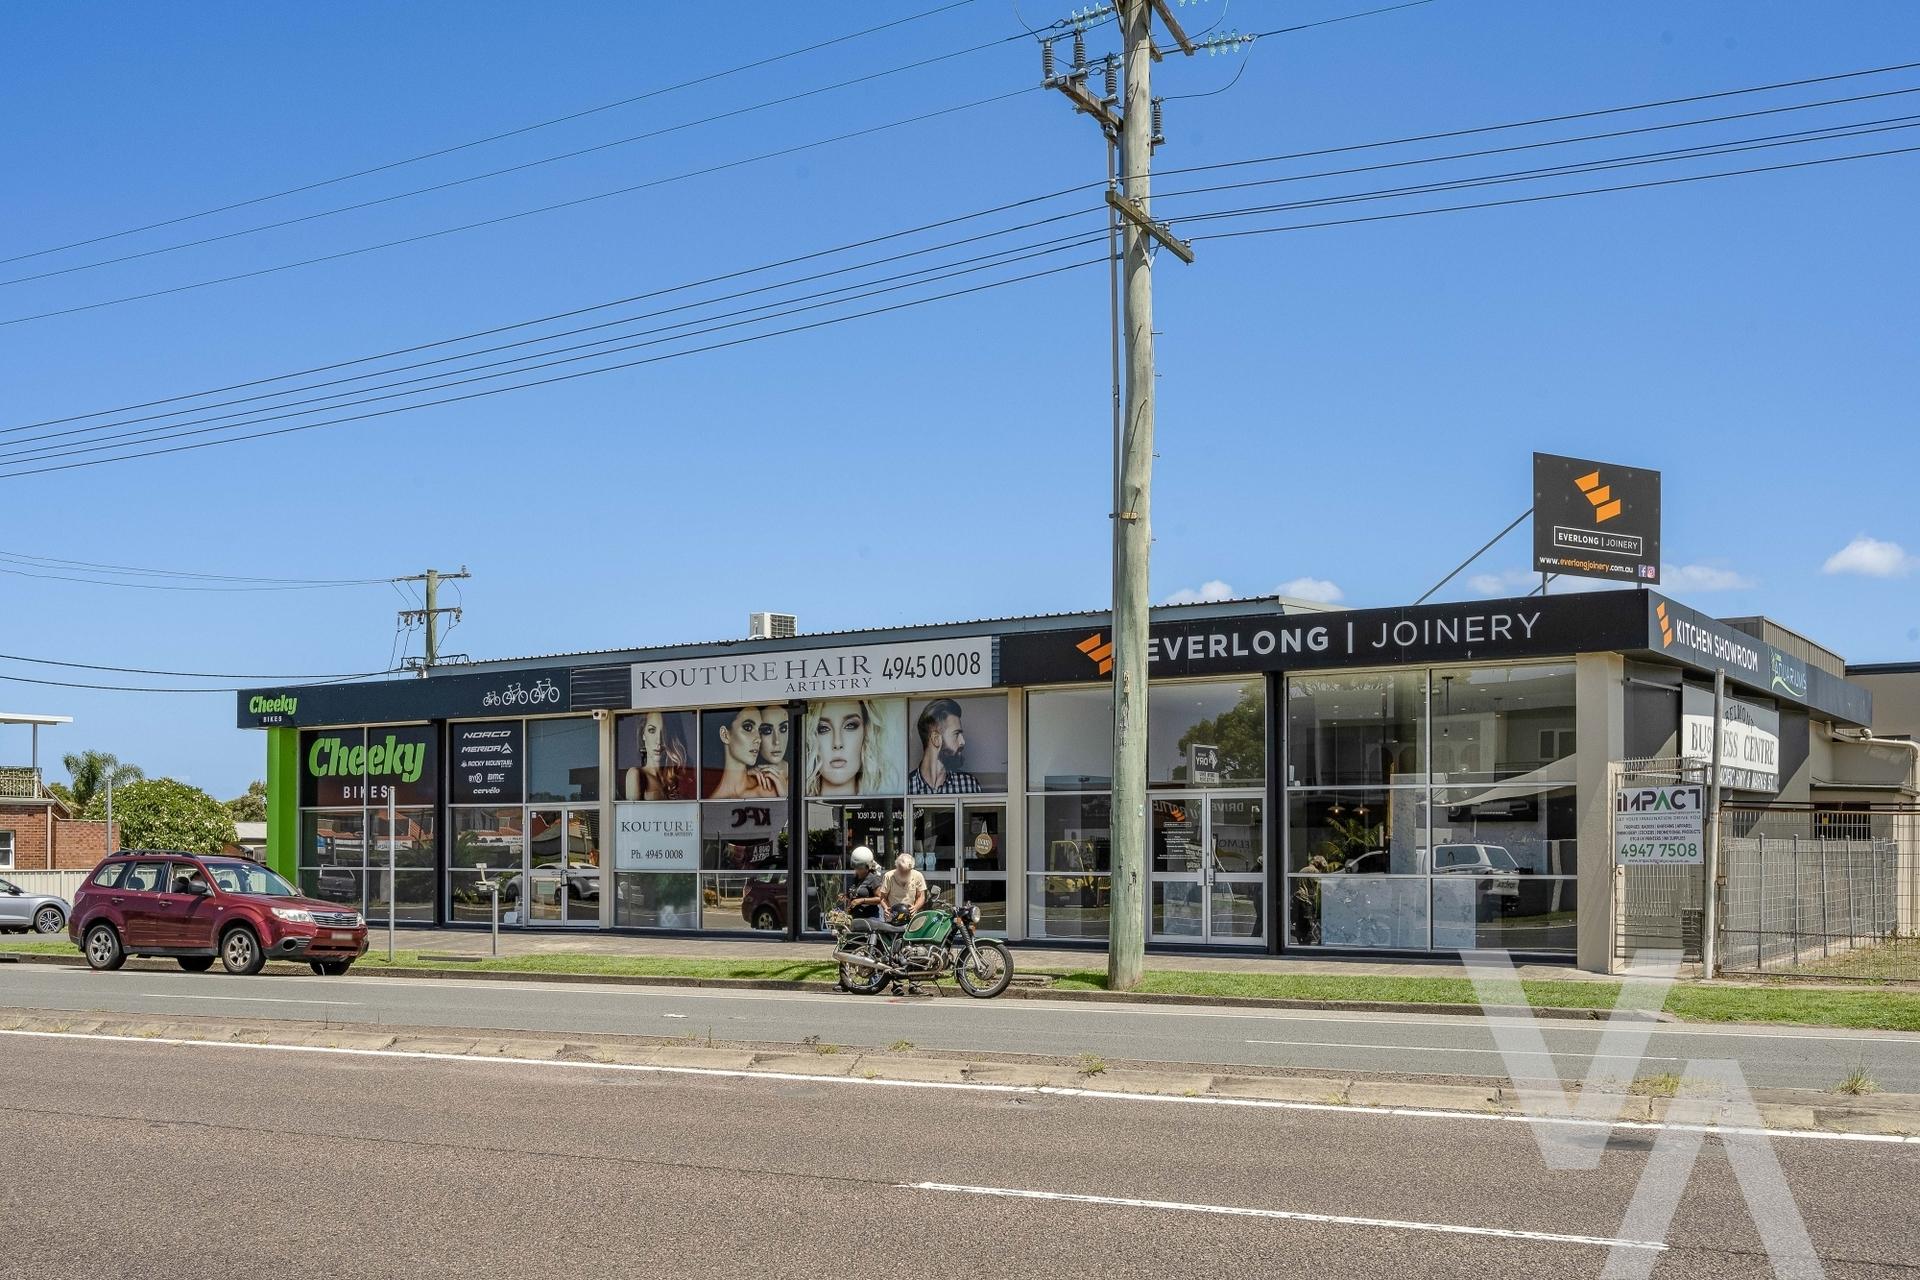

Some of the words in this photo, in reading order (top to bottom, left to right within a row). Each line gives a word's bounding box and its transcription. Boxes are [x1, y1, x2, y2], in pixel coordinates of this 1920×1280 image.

[1558, 532, 1599, 545] EVERLONG
[1605, 539, 1638, 550] JOINERY
[1539, 556, 1634, 573] www.everlongjoinery.com.au
[1147, 626, 1329, 662] EVERLONG
[1371, 611, 1541, 648] JOINERY
[1676, 618, 1713, 655] KITCHEN
[1714, 634, 1759, 672] SHOWROOM
[639, 661, 778, 690] KOUTURE
[785, 655, 872, 680] HAIR
[882, 655, 926, 680] 4945
[931, 651, 981, 677] 0008
[785, 677, 872, 693] ARTISTRY
[249, 694, 298, 715] Cheeky
[263, 715, 283, 723] BIKES
[1725, 703, 1755, 733] BELMONT
[462, 730, 512, 739] NORCO
[461, 745, 502, 753] MERIDA
[1691, 722, 1739, 759] BUSESS
[1743, 735, 1775, 766] CENTRE
[308, 735, 426, 783] Cheeky
[343, 785, 389, 799] BIKES
[621, 820, 694, 832] KOUTURE
[645, 849, 663, 859] 4945
[664, 849, 684, 859] 0008
[1621, 843, 1655, 857] 4947
[1659, 843, 1698, 857] 7508
